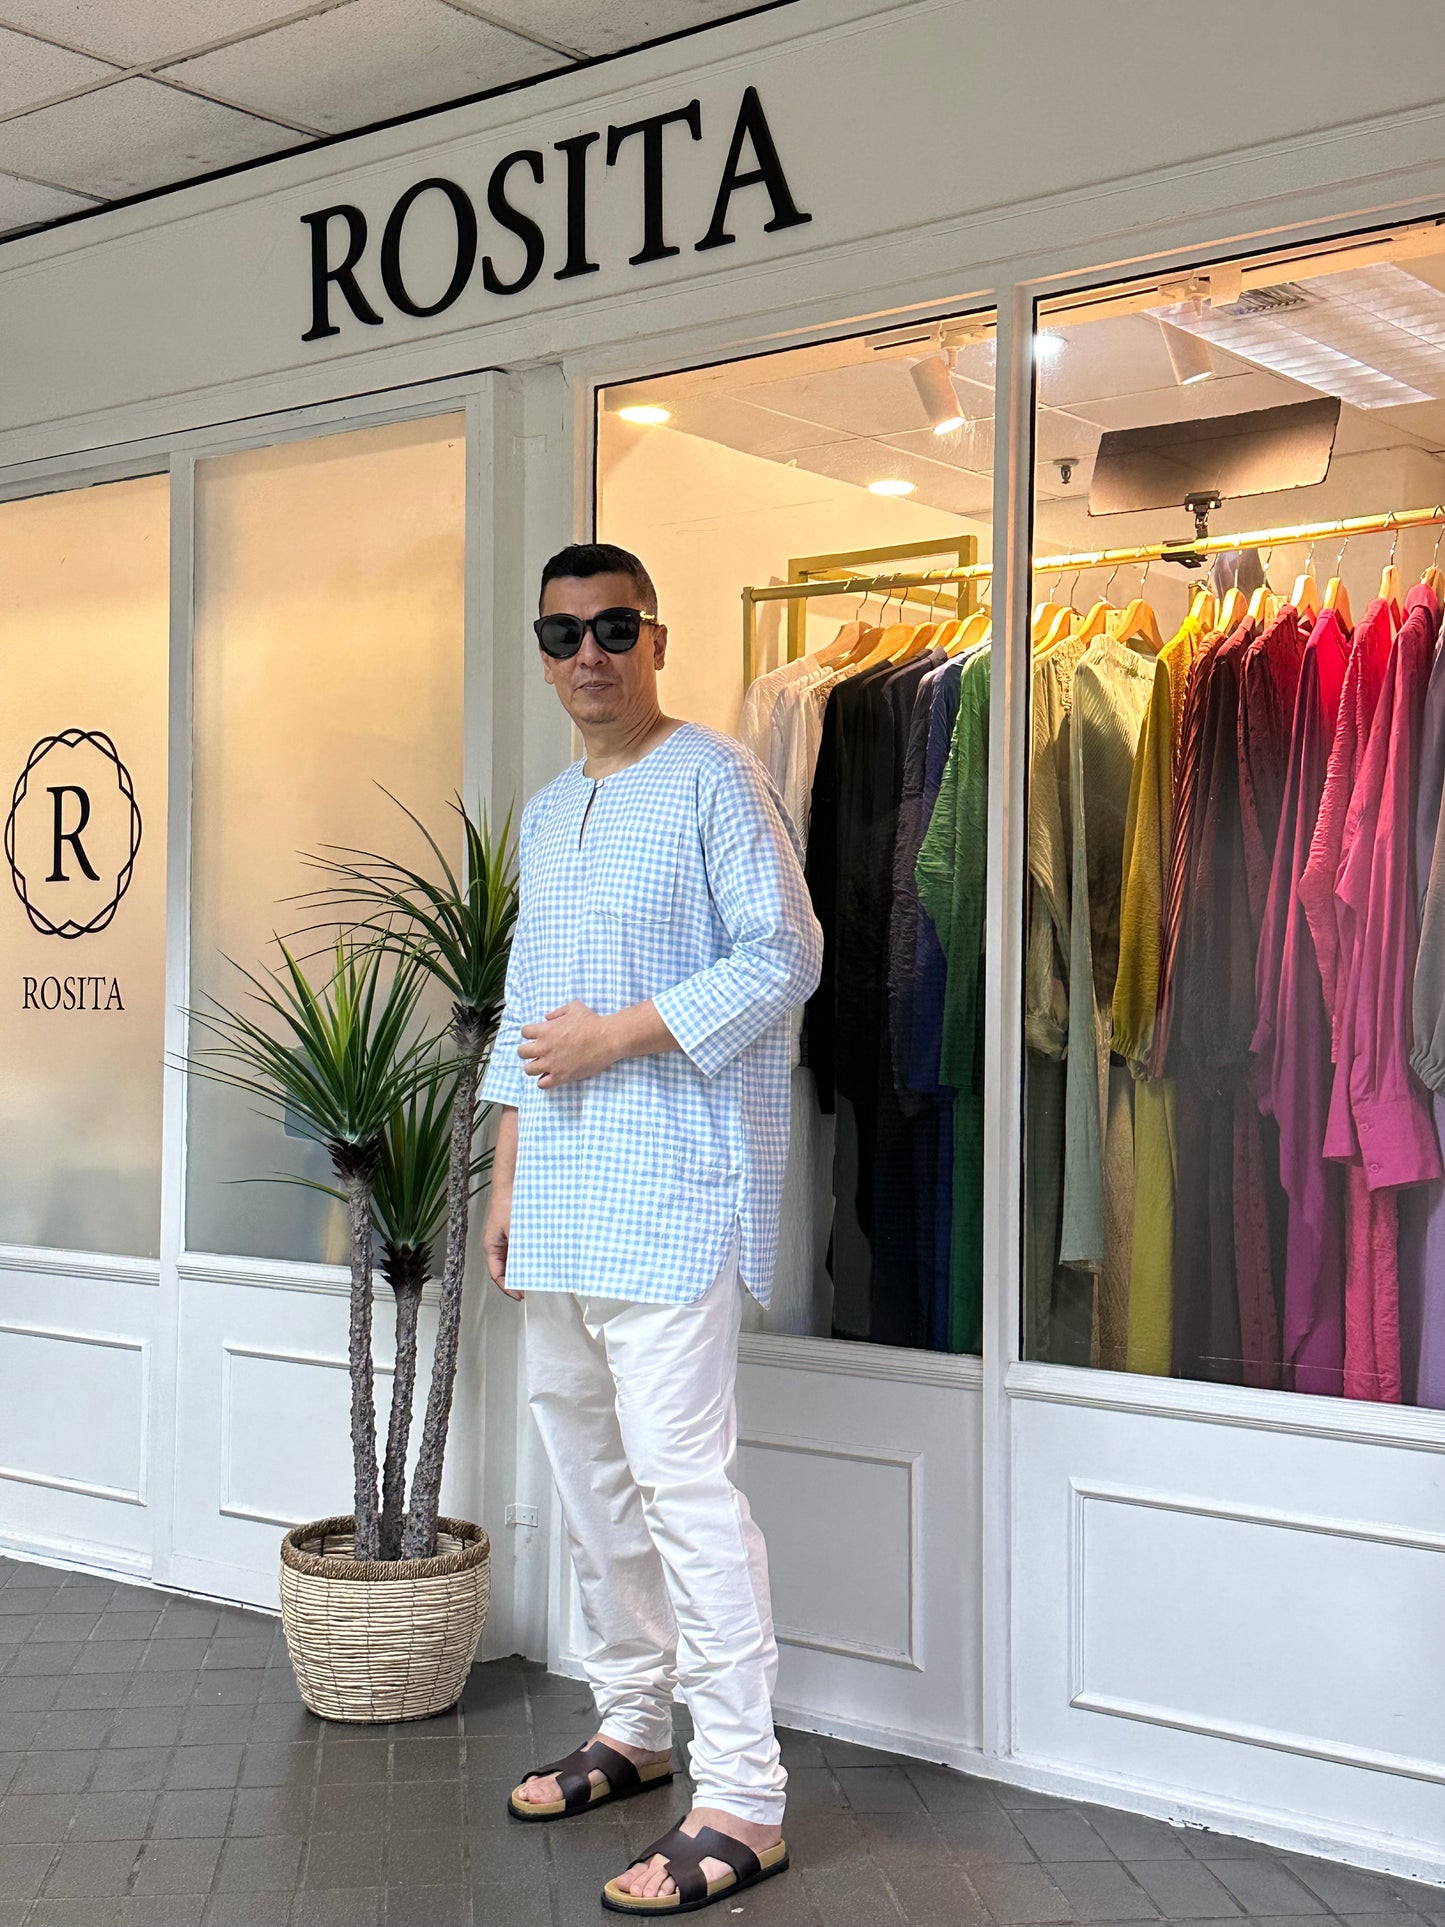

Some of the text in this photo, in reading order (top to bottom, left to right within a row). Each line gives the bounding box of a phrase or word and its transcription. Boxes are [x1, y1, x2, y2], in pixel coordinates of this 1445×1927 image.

[301, 85, 812, 341] ROSITA
[46, 785, 100, 882] R
[22, 976, 126, 1011] ROSITA
